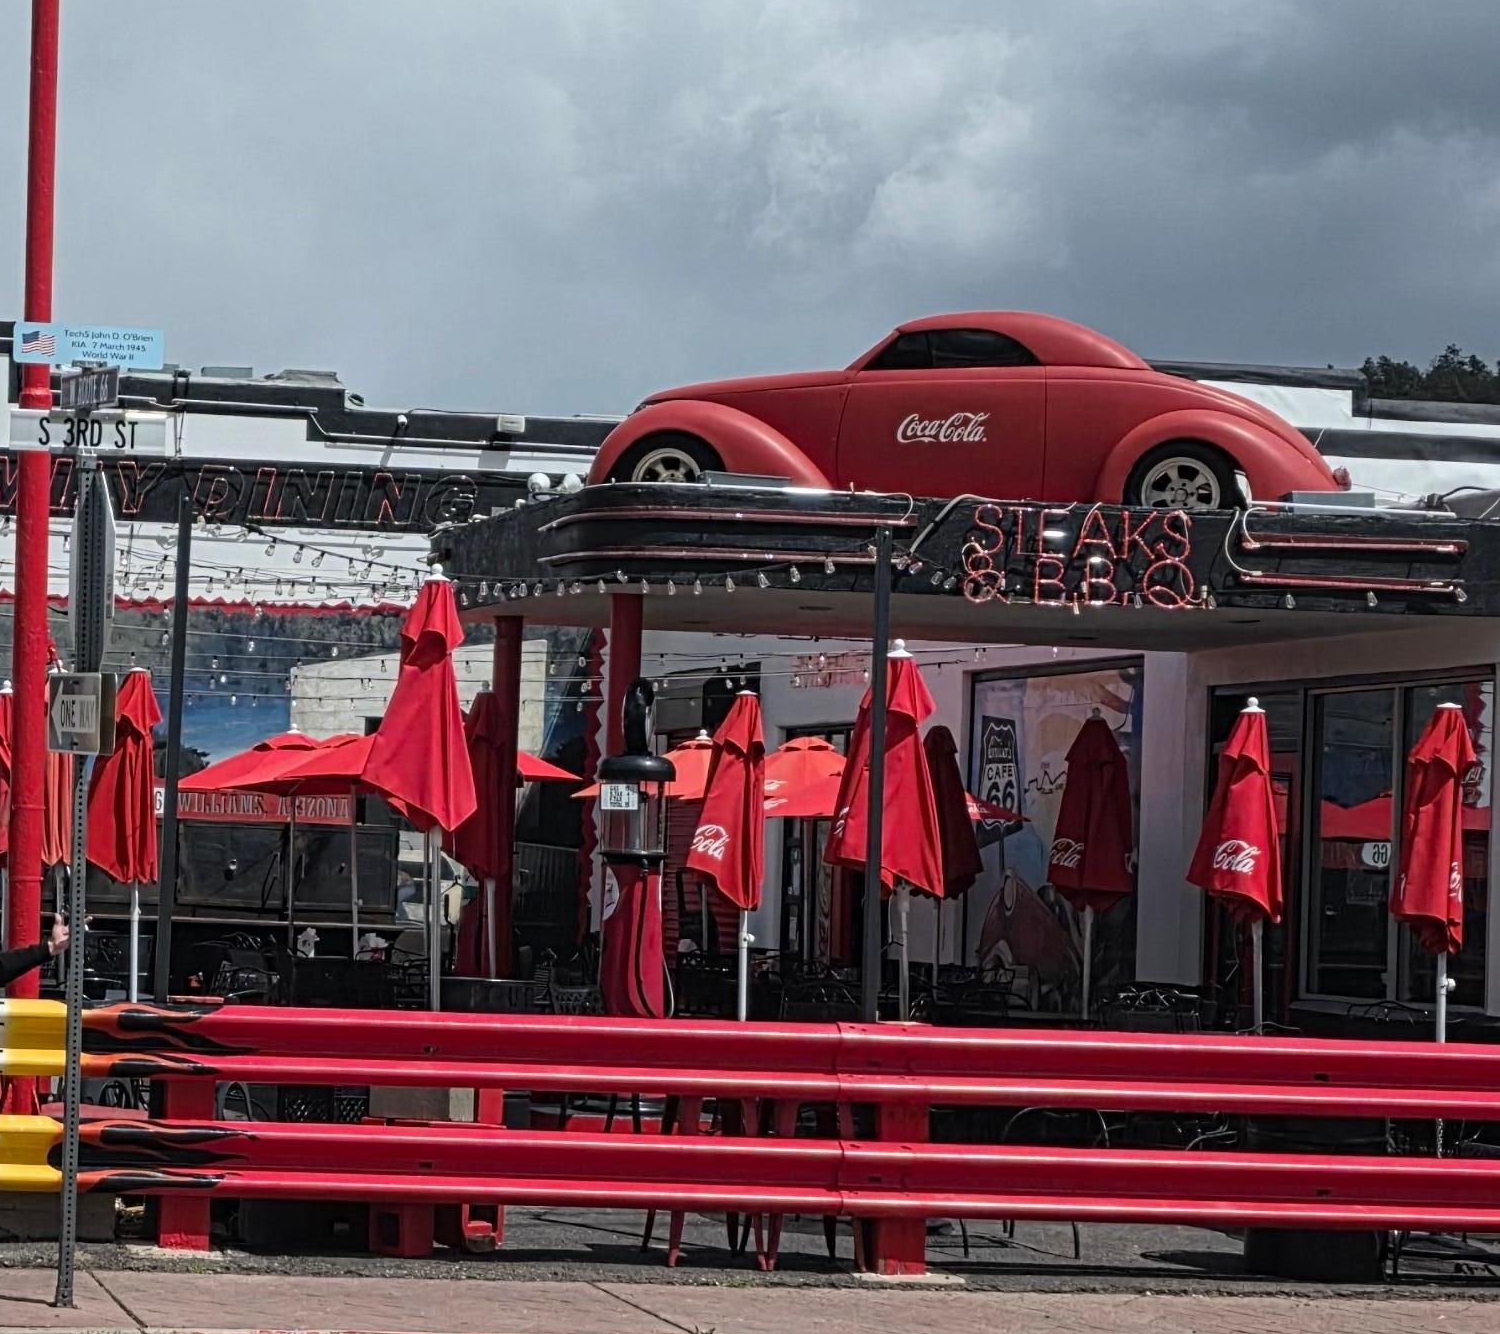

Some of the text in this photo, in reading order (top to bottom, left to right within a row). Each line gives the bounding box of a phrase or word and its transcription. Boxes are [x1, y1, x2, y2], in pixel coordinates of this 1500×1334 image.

[92, 331, 111, 340] John
[123, 334, 154, 342] O'Brien
[100, 342, 125, 351] March
[127, 344, 146, 352] 1945
[82, 351, 108, 359] World
[111, 352, 127, 360] War
[77, 374, 98, 406] ROUTE
[100, 373, 109, 402] 66
[38, 417, 138, 449] S 3RD ST
[192, 464, 477, 527] DINING
[974, 504, 1193, 561] STEAKS
[60, 699, 95, 728] ONE WAY
[987, 765, 1013, 780] CAFE
[986, 779, 1016, 812] 66
[1213, 839, 1261, 875] Cola
